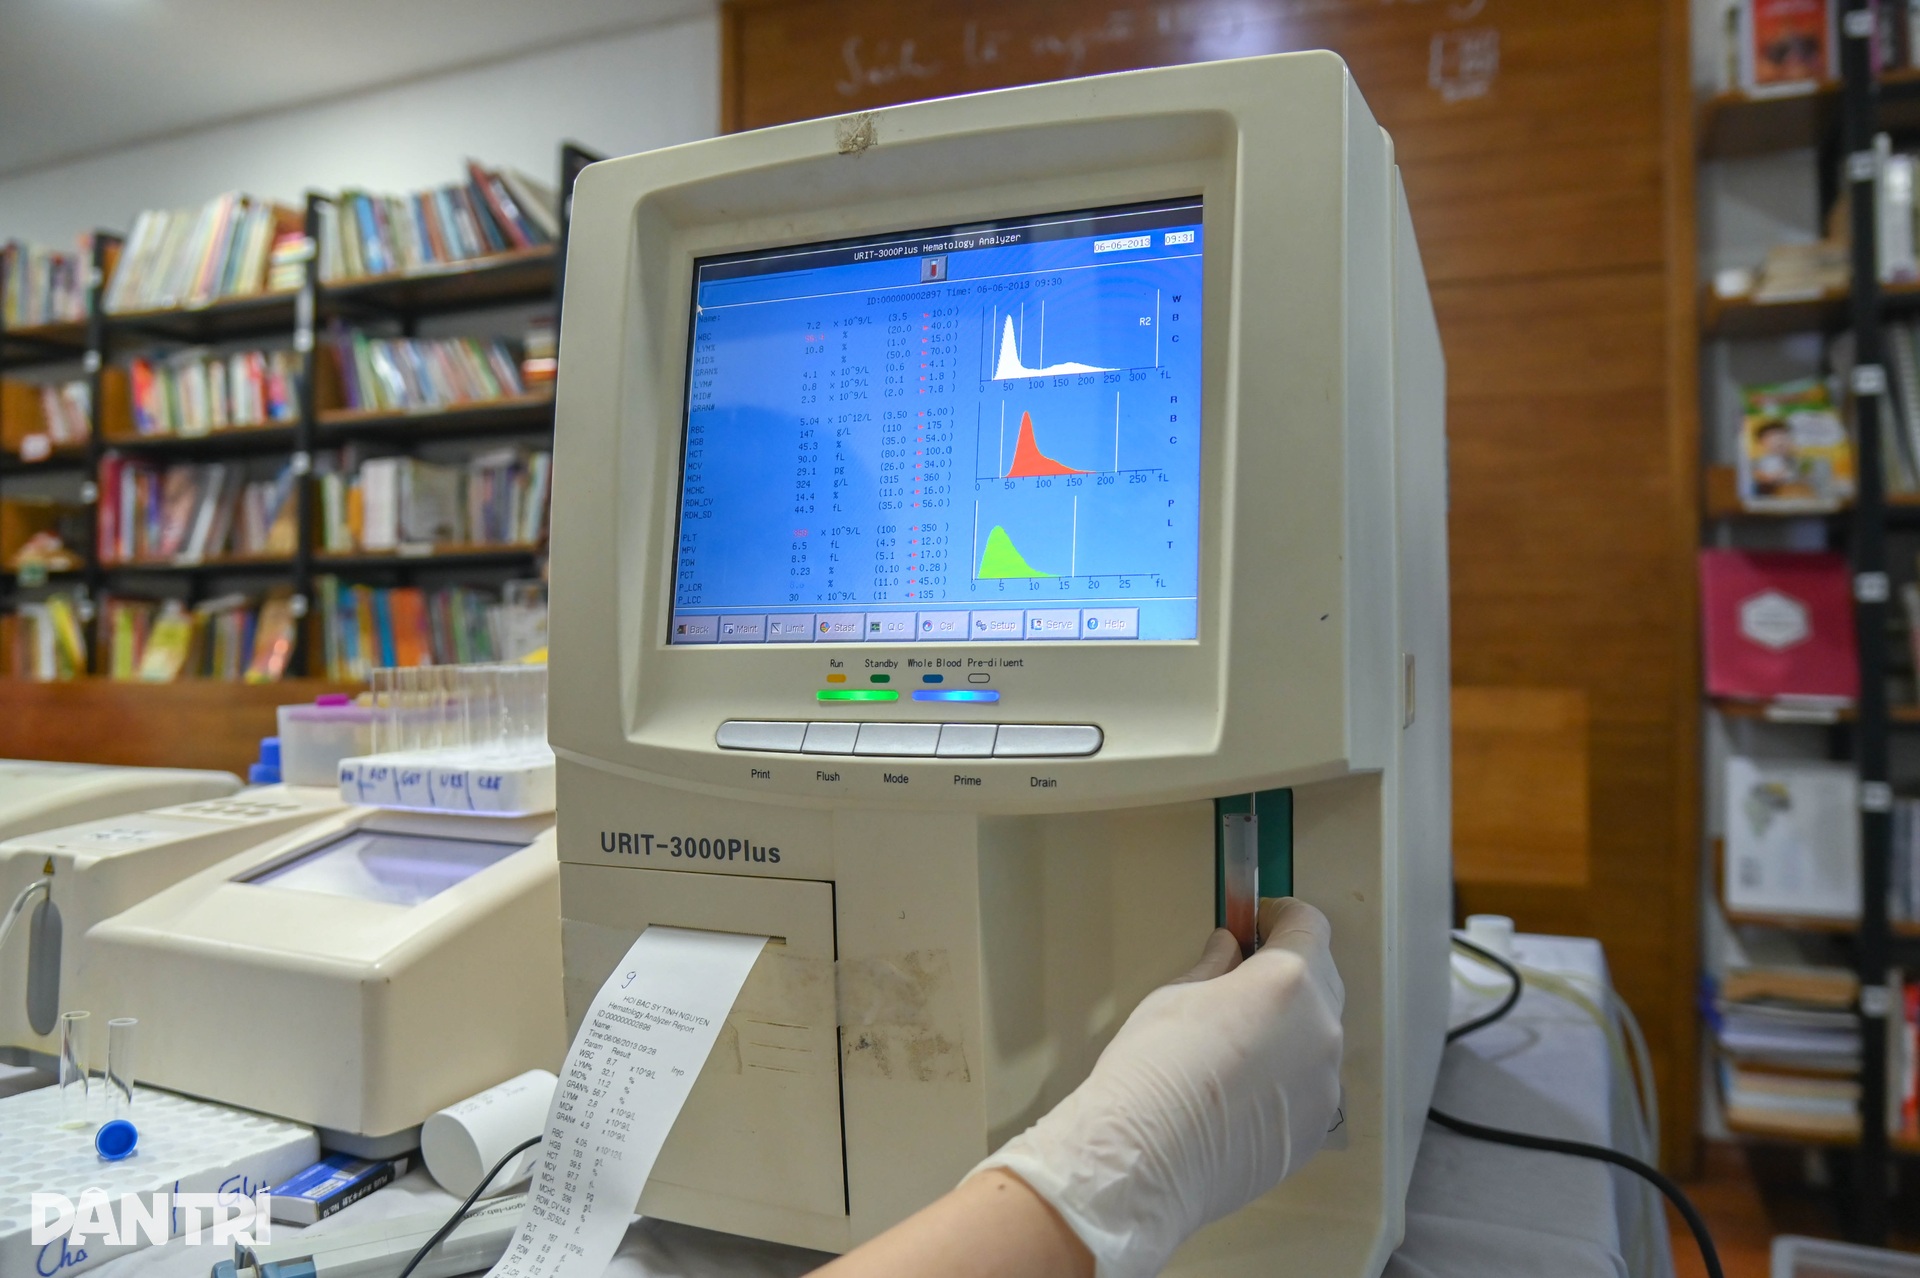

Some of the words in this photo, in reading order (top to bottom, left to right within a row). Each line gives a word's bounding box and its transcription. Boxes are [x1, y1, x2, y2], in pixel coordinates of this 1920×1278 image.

[854, 246, 918, 260] URIT-3000Plus
[923, 241, 974, 252] Hematology
[979, 234, 1021, 245] Analyzer
[1094, 238, 1151, 252] 06-06-2013
[1165, 234, 1194, 244] 09:31
[947, 287, 971, 296] Time:
[977, 282, 1029, 293] 06-06-2013
[1035, 277, 1063, 287] 09:30
[807, 322, 821, 330] 7.2
[1140, 317, 1151, 326] R2
[805, 346, 824, 354] 10.8
[803, 371, 817, 379] 4.1
[979, 385, 985, 393] 0
[1003, 383, 1014, 391] 50
[1029, 380, 1045, 389] 100
[1054, 378, 1069, 388] 150
[1078, 376, 1095, 386] 200
[1104, 374, 1121, 384] 250
[1129, 372, 1146, 381] 300
[1160, 370, 1171, 380] fL
[801, 395, 816, 404] 2.3
[690, 426, 704, 434] RBC
[800, 417, 819, 426] 5.04
[799, 430, 814, 438] 147
[836, 428, 851, 437] g/L
[689, 450, 703, 458] HCT
[798, 442, 818, 451] 45.3
[688, 462, 703, 470] MCV
[798, 455, 817, 463] 90.0
[836, 452, 845, 461] fL
[687, 474, 701, 482] MCH
[796, 467, 816, 476] 29.1
[835, 466, 845, 475] pg
[686, 486, 705, 494] MCHC
[796, 480, 811, 489] 324
[834, 478, 848, 488] g/L
[975, 483, 980, 491] 0
[1005, 481, 1015, 489] 50
[1036, 479, 1052, 488] 100
[1066, 477, 1083, 487] 150
[1097, 476, 1115, 485] 200
[1129, 475, 1147, 483] 250
[1159, 472, 1169, 482] fL
[796, 493, 815, 502] 14.4
[794, 505, 814, 514] 44.9
[833, 504, 842, 513] fL
[682, 533, 698, 542] PLT
[682, 546, 696, 555] MPV
[792, 542, 807, 551] 6.5
[831, 540, 839, 549] fL
[791, 554, 806, 563] 8.9
[830, 553, 839, 562] fL
[680, 571, 694, 580] PCT
[790, 567, 811, 576] 0.23
[971, 583, 976, 591] 0
[999, 583, 1004, 591] 5
[1030, 582, 1040, 591] 10
[1059, 581, 1070, 590] 15
[1089, 580, 1100, 589] 20
[1119, 579, 1131, 589] 25
[1156, 579, 1166, 588] fL
[788, 593, 799, 602] 30
[690, 625, 710, 635] Back
[785, 623, 805, 634] Limit
[940, 620, 955, 630] Cal
[990, 619, 1016, 632] Setup
[1046, 618, 1073, 630] Serve
[1105, 618, 1126, 630] Help
[830, 658, 844, 669] Run
[864, 658, 899, 670] Standby
[907, 657, 932, 669] Whole
[936, 657, 962, 669] Blood
[967, 657, 1024, 669] Pre-diluent
[751, 768, 771, 780] Print
[816, 771, 841, 782] Flush
[883, 773, 909, 784] Mode
[953, 774, 982, 787] Prime
[1030, 776, 1057, 788] Drain
[600, 831, 781, 864] URIT-3000Plus
[608, 1001, 644, 1019] Hematology
[644, 1012, 672, 1027] Analyzer
[671, 1020, 695, 1034] Report
[637, 1000, 652, 1009] BAC
[652, 1004, 662, 1012] SY
[661, 1006, 678, 1017] TINH
[678, 1011, 710, 1027] NGUYEN
[584, 1038, 604, 1051] Param
[611, 1047, 632, 1059] Result
[579, 1048, 595, 1060] WBC
[606, 1057, 618, 1067] 8.7
[601, 1067, 616, 1078] 32.1
[597, 1078, 612, 1088] 11.2
[592, 1088, 607, 1098] 56.7
[585, 1110, 594, 1119] 1.0
[551, 1127, 564, 1139] RBC
[575, 1137, 588, 1148] 4.05
[546, 1150, 558, 1160] HCT
[573, 1149, 583, 1158] 133
[544, 1161, 557, 1172] MCV
[463, 1202, 527, 1220] gon-lab.com
